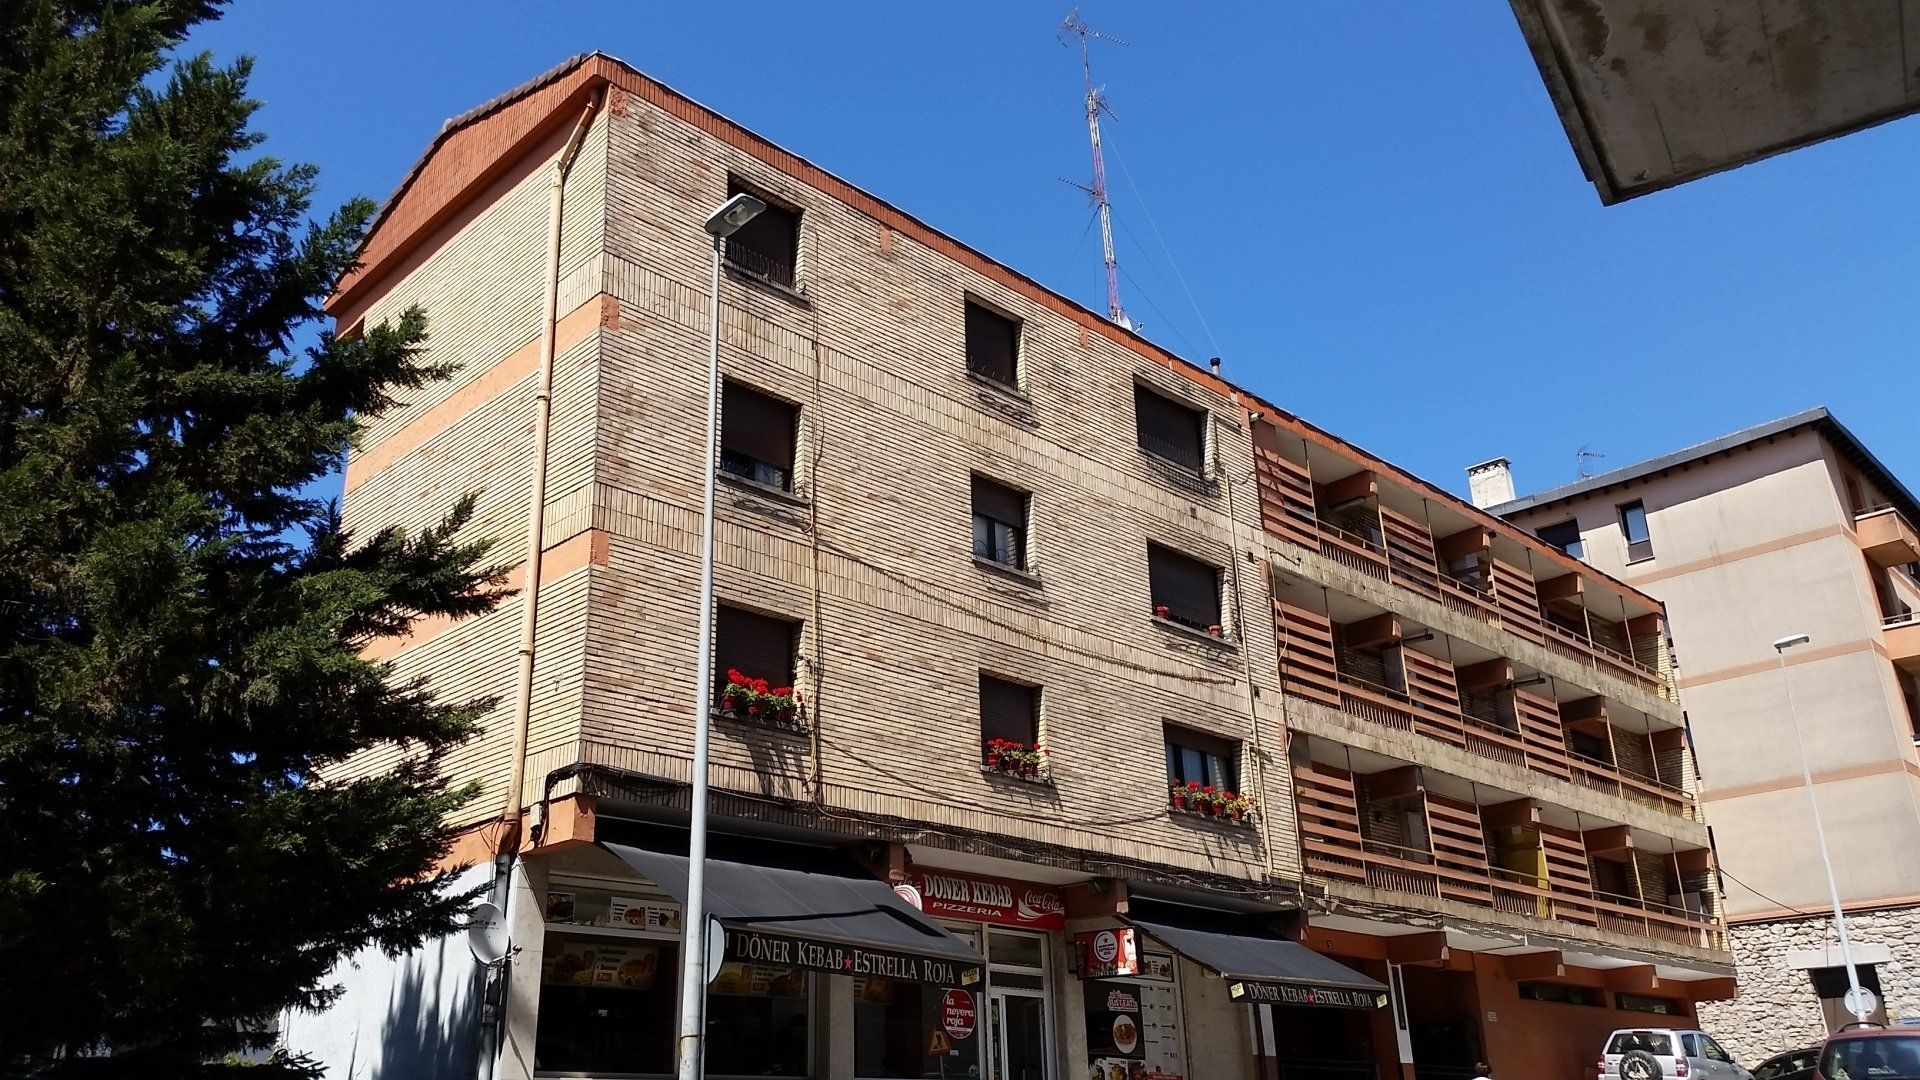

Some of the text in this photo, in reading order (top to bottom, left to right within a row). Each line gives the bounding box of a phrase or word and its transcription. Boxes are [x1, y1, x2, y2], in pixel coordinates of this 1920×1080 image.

[923, 873, 971, 903] DONER
[971, 880, 1013, 908] KEBAB
[932, 902, 1002, 917] PIZZERIA
[737, 932, 955, 984] DÖNER KEBAB ESTRELLA ROJA
[946, 995, 955, 1006] la
[1248, 982, 1373, 1007] DÖNER KEBAB ESTRELLA ROJA
[946, 1017, 965, 1027] roja
